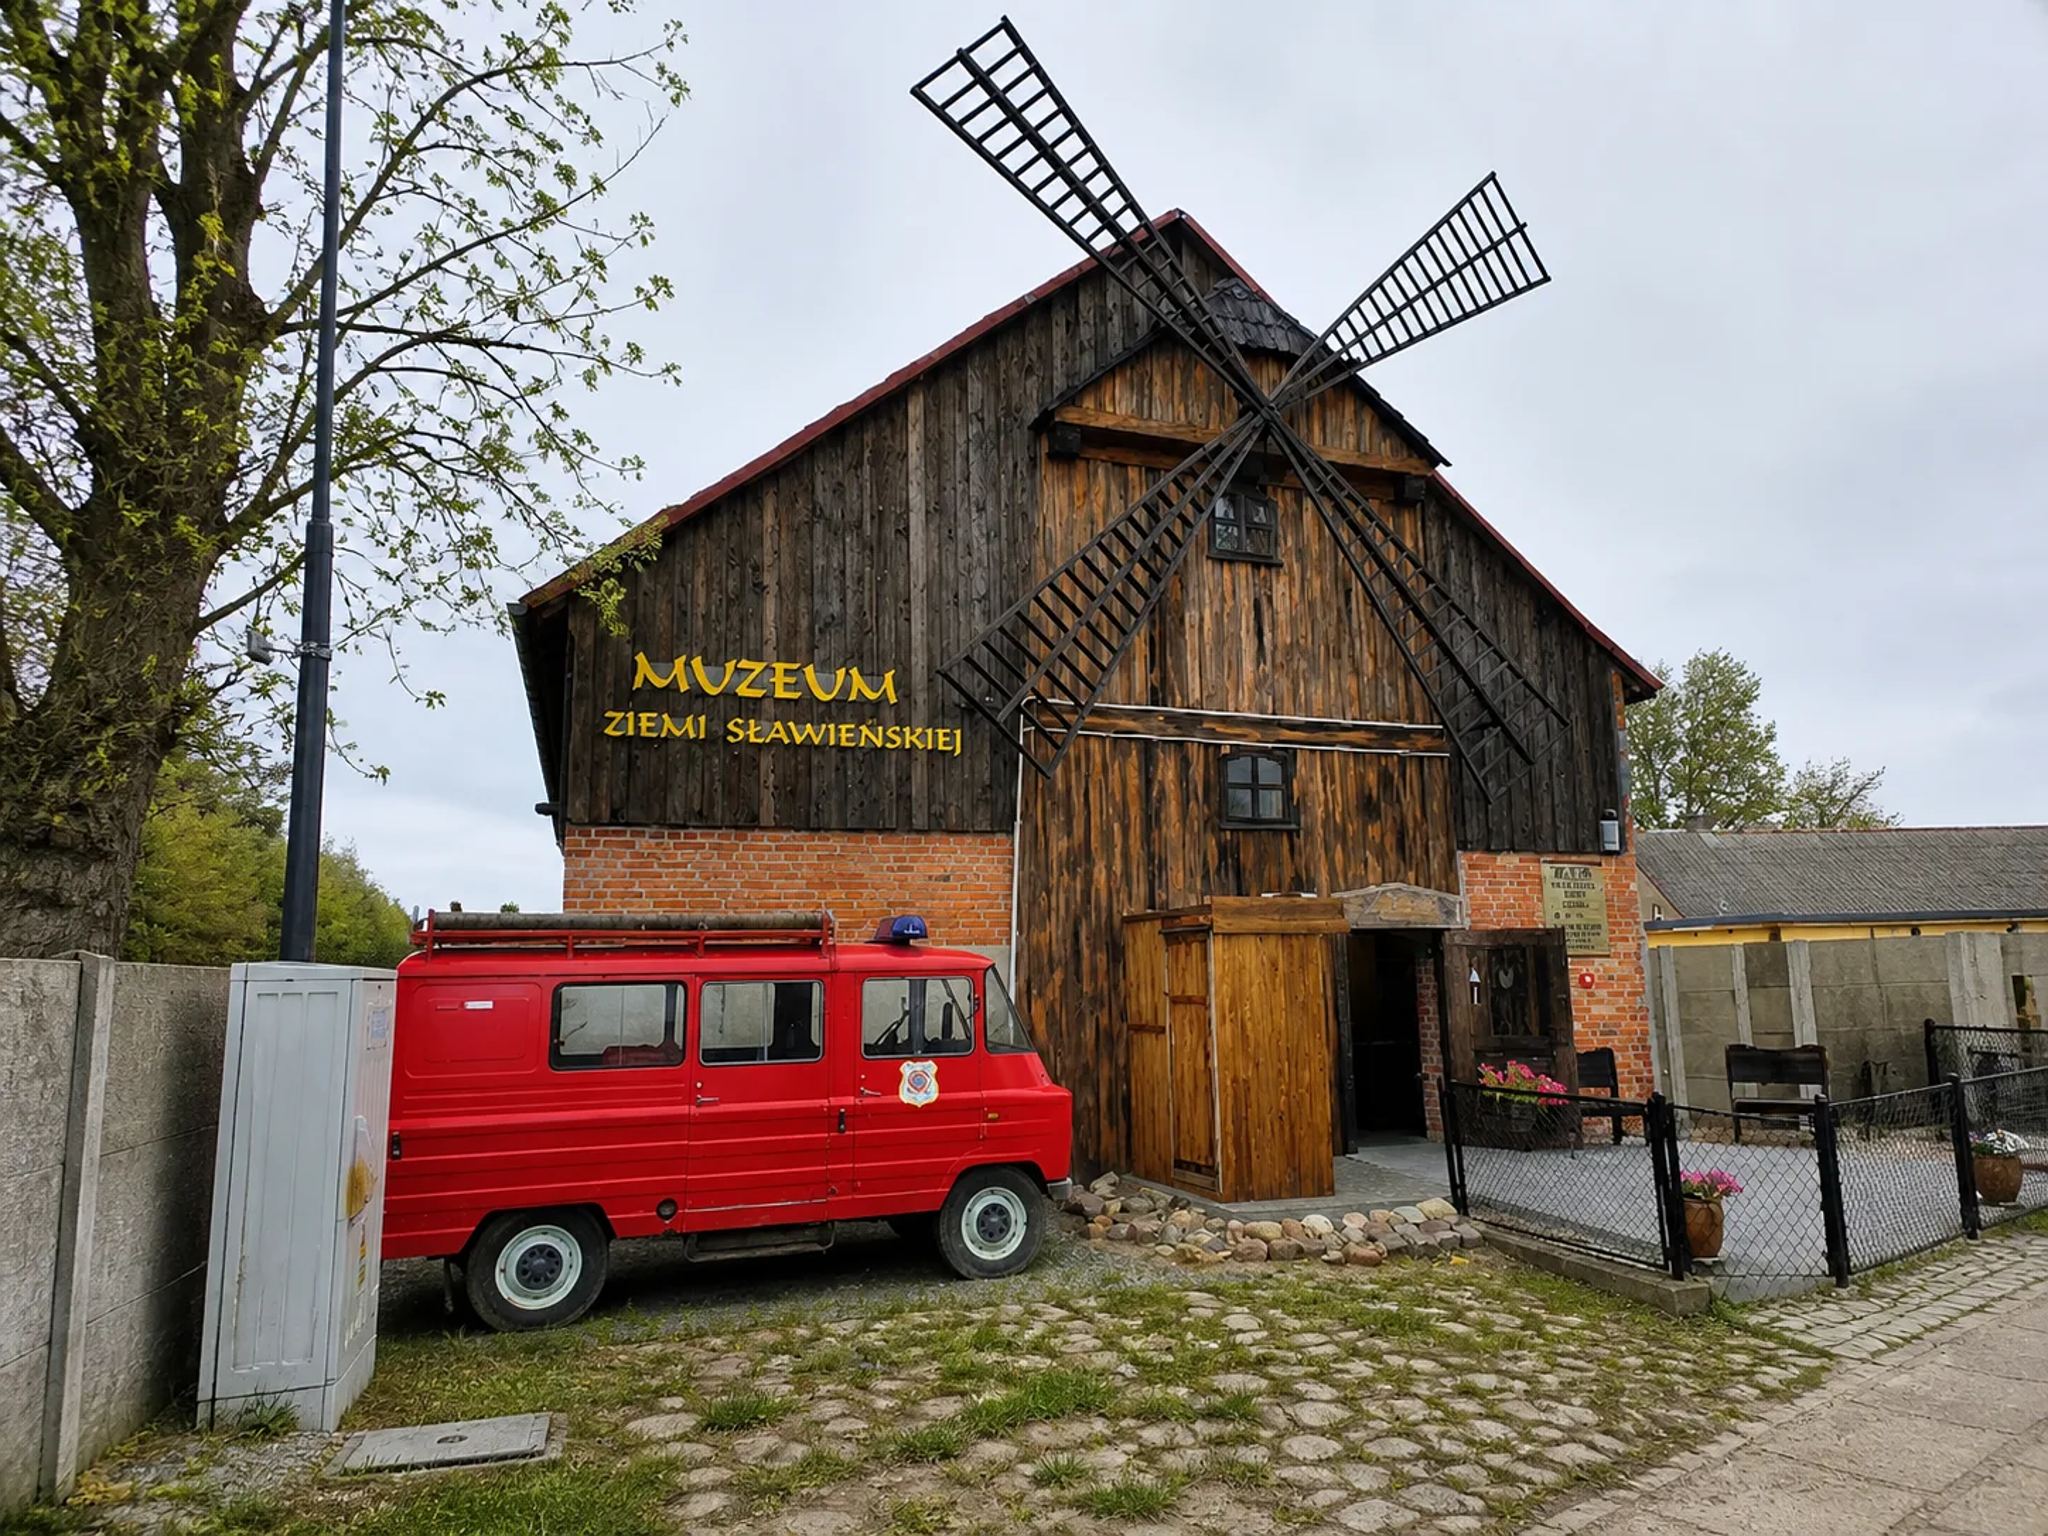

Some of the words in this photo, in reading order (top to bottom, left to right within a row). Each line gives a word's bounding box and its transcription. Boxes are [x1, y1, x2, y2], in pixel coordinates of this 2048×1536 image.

[632, 651, 898, 705] MUZEUM
[603, 710, 707, 740] ZIEMI
[726, 717, 963, 757] SŁAWIEŃSKIEJ
